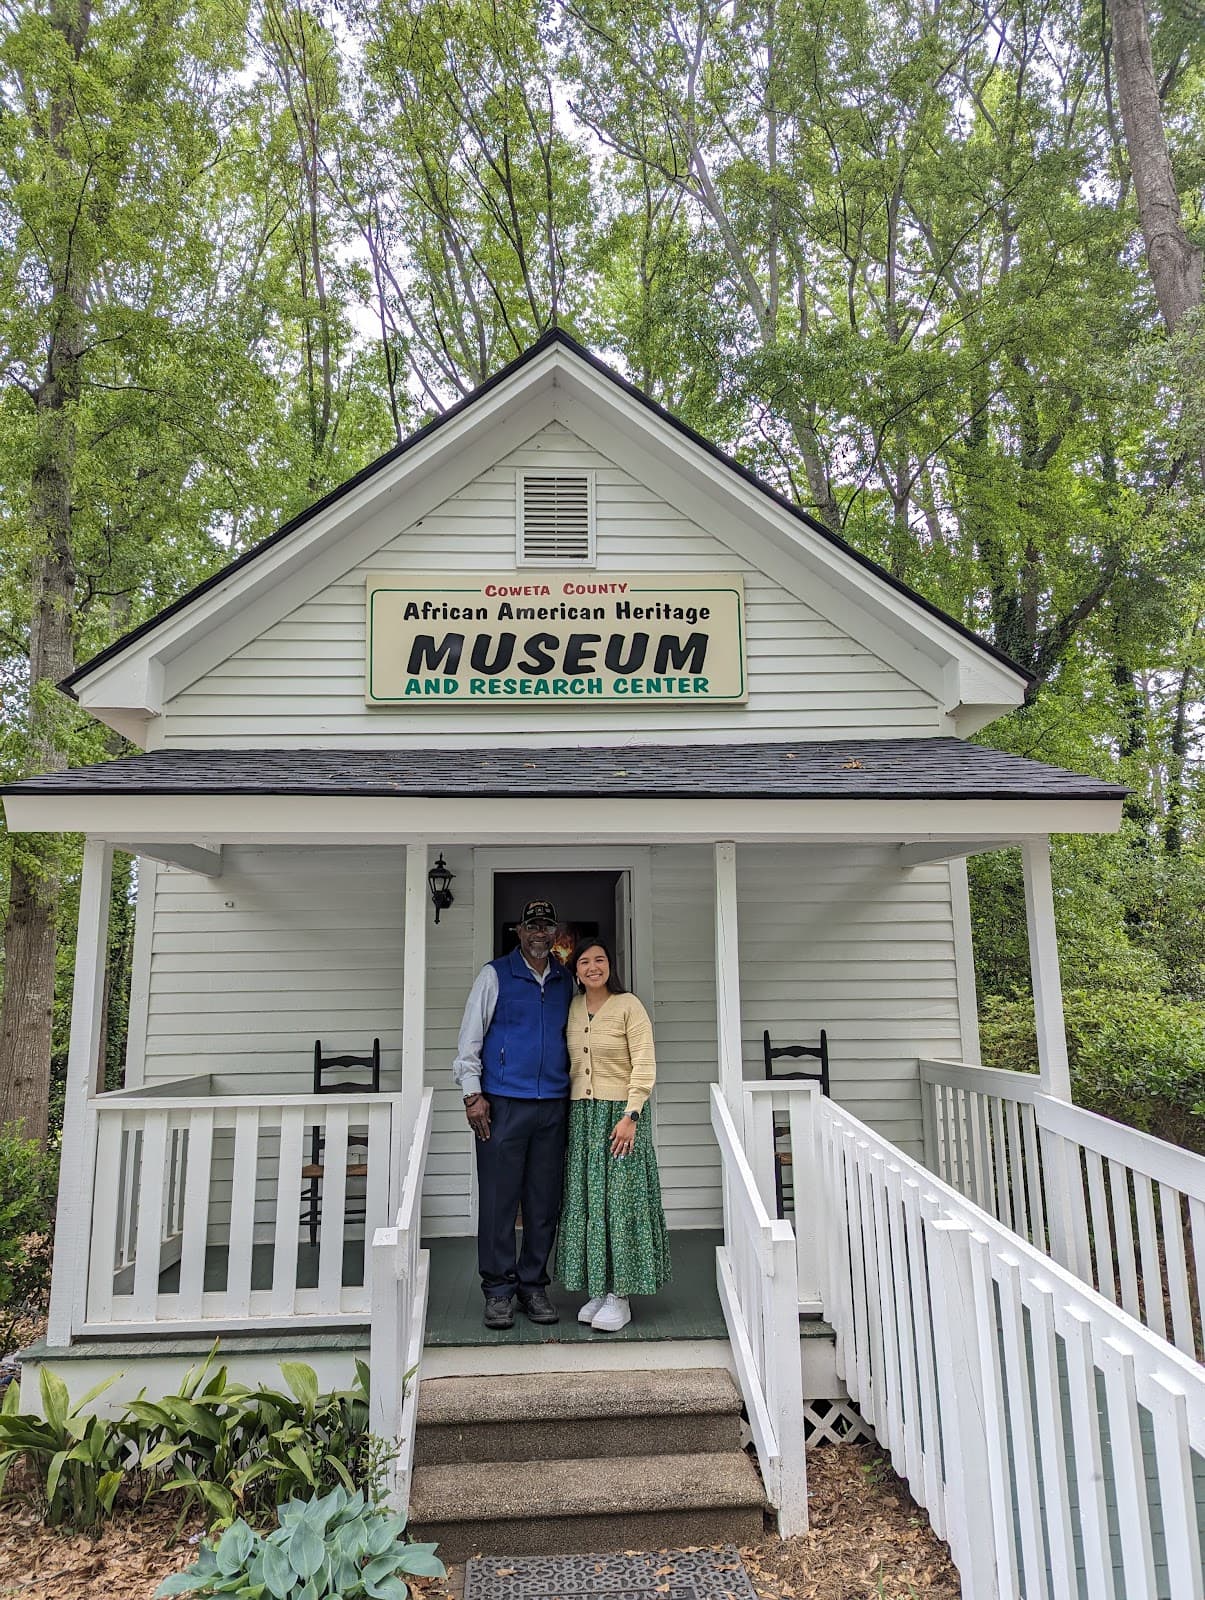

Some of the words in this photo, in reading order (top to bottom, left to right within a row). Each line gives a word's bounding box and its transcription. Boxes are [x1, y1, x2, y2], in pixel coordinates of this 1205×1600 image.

[485, 584, 551, 597] COWETA
[563, 582, 628, 595] COUNTY
[403, 602, 488, 621] African
[497, 602, 605, 621] American
[616, 601, 711, 625] Heritage
[406, 632, 709, 675] MUSEUM
[405, 678, 459, 695] AND
[470, 678, 602, 695] RESEARCH
[613, 677, 709, 694] CENTER
